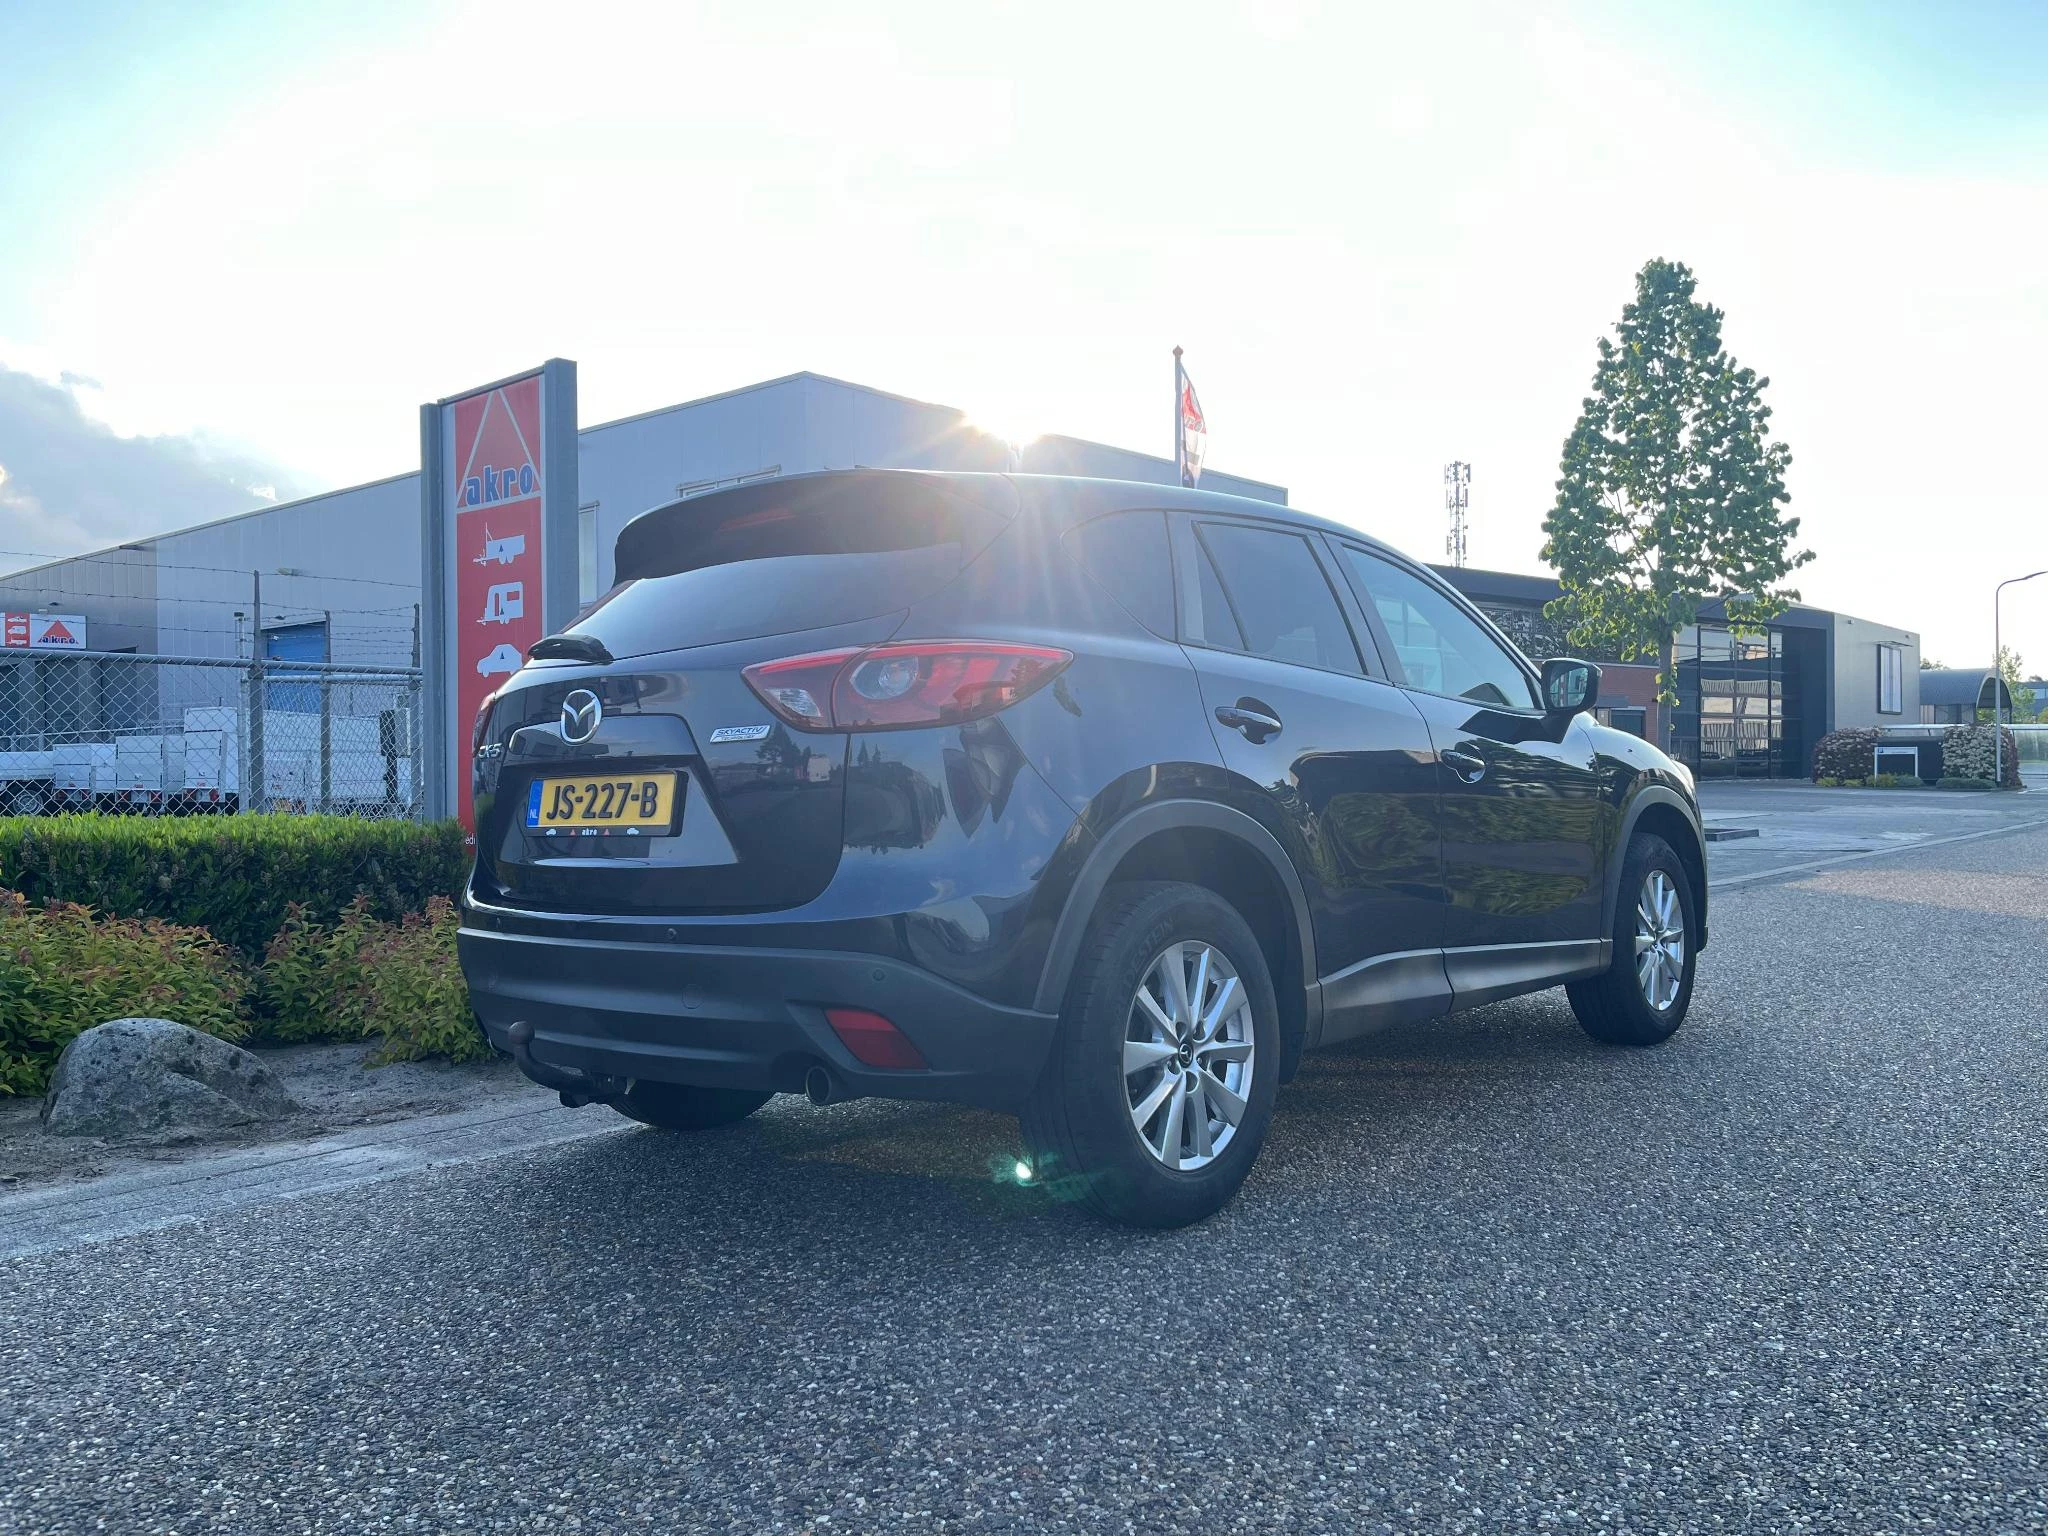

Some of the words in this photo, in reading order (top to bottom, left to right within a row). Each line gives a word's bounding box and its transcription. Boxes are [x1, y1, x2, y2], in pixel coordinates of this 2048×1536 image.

[465, 463, 534, 505] akro
[42, 635, 76, 644] akro
[718, 726, 764, 735] SKYACTIV
[546, 781, 659, 820] JS-227-B
[529, 808, 538, 819] NL
[581, 827, 598, 836] akro
